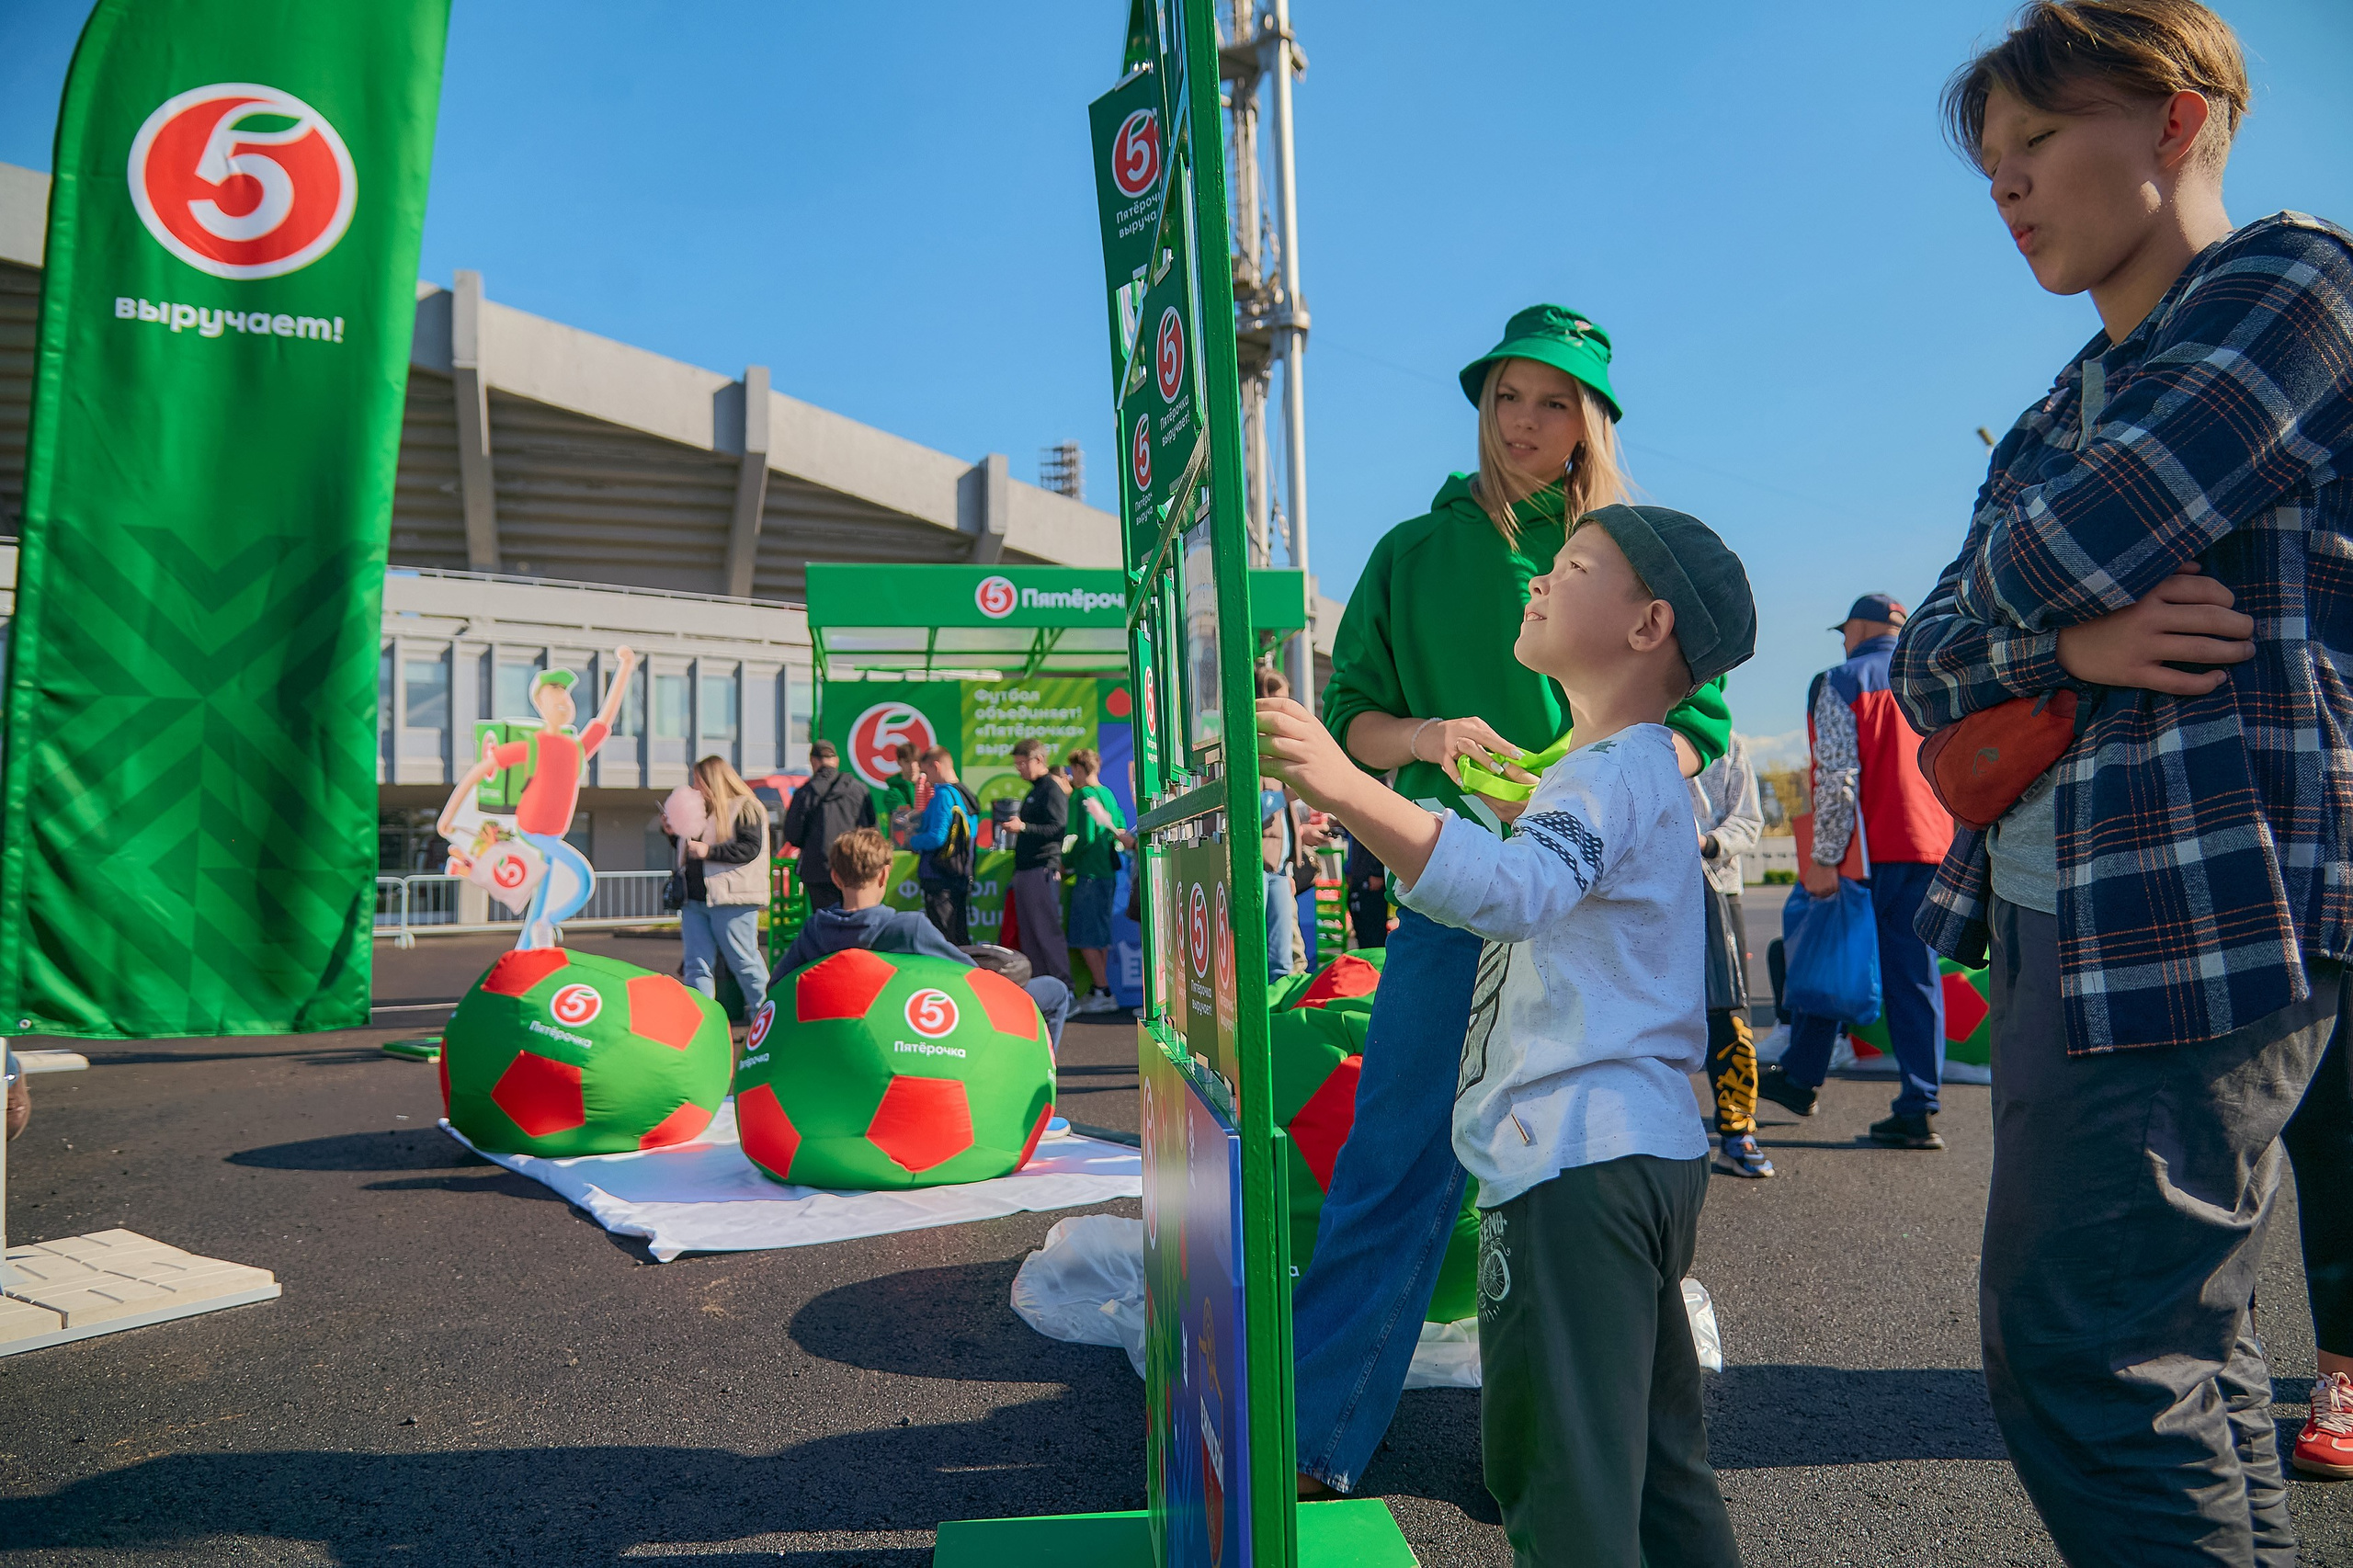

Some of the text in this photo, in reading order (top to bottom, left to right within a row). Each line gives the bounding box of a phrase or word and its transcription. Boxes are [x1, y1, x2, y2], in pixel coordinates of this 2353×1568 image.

[1116, 190, 1161, 224] Пятёроч
[1119, 210, 1157, 239] выруча
[115, 296, 346, 344] выручает!
[1160, 393, 1189, 431] Пятёрочка
[1162, 412, 1190, 448] выручает!
[1136, 506, 1153, 526] выруча
[1021, 587, 1125, 614] Пятёроч
[974, 687, 1040, 705] Футбол
[974, 705, 1083, 721] объединяет!
[975, 743, 1061, 758] вырет
[529, 1020, 593, 1049] Пятёрочка
[893, 1040, 966, 1058] Пятёрочка
[1479, 1210, 1505, 1248] GEND
